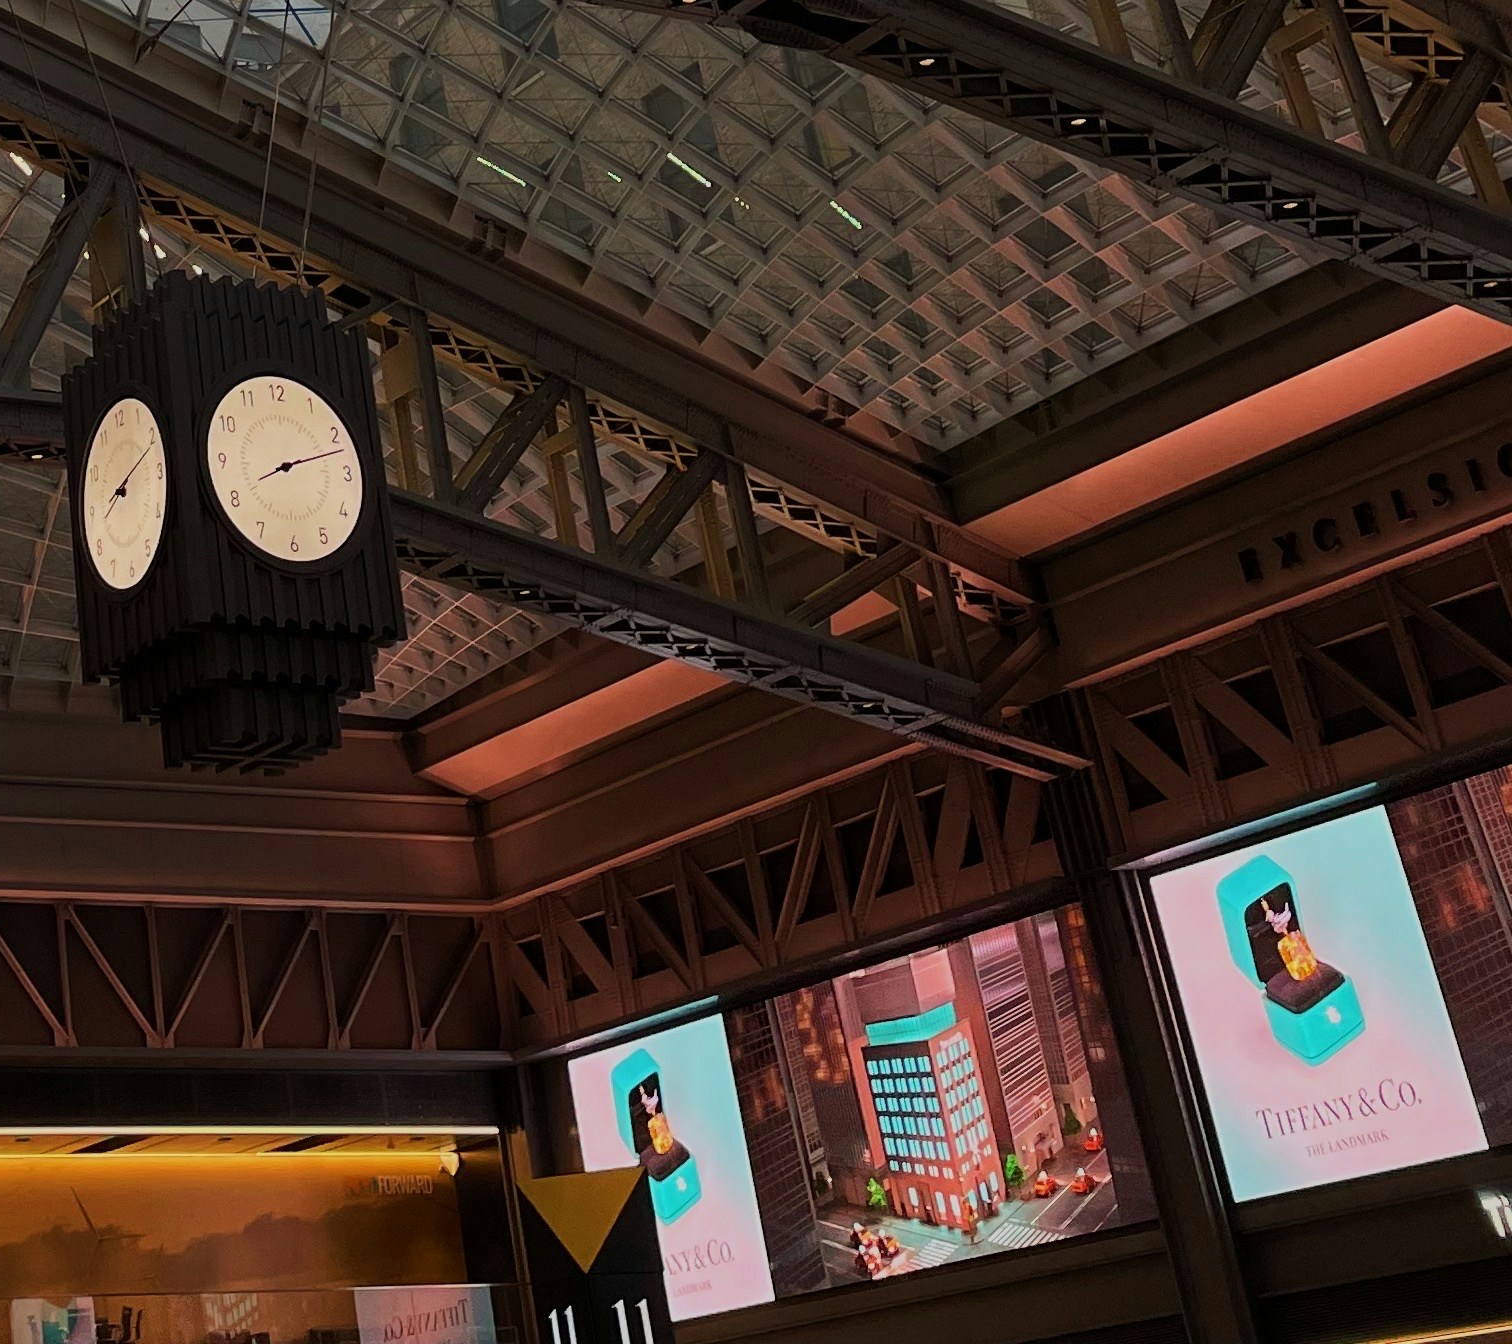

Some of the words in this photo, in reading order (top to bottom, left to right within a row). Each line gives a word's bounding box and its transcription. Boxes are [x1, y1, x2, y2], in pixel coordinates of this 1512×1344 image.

[239, 389, 254, 407] 11
[268, 383, 286, 403] 12
[307, 397, 314, 414] 1
[114, 409, 125, 429] 12
[135, 408, 141, 425] 1
[219, 414, 236, 433] 10
[100, 429, 108, 446] 11
[148, 427, 156, 445] 2
[330, 426, 340, 444] 2
[218, 452, 227, 470] 9
[90, 464, 99, 483] 10
[156, 462, 163, 480] 3
[343, 465, 352, 482] 3
[230, 490, 240, 508] 8
[339, 500, 348, 519] 4
[256, 521, 265, 539] 7
[318, 527, 329, 545] 5
[96, 539, 103, 556] 8
[144, 538, 151, 557] 5
[290, 534, 299, 553] 6
[110, 558, 116, 577] 7
[129, 560, 135, 578] 6
[1305, 1142, 1328, 1158] THE
[1328, 1129, 1391, 1154] LANDMARK
[377, 1174, 434, 1196] FORWARD
